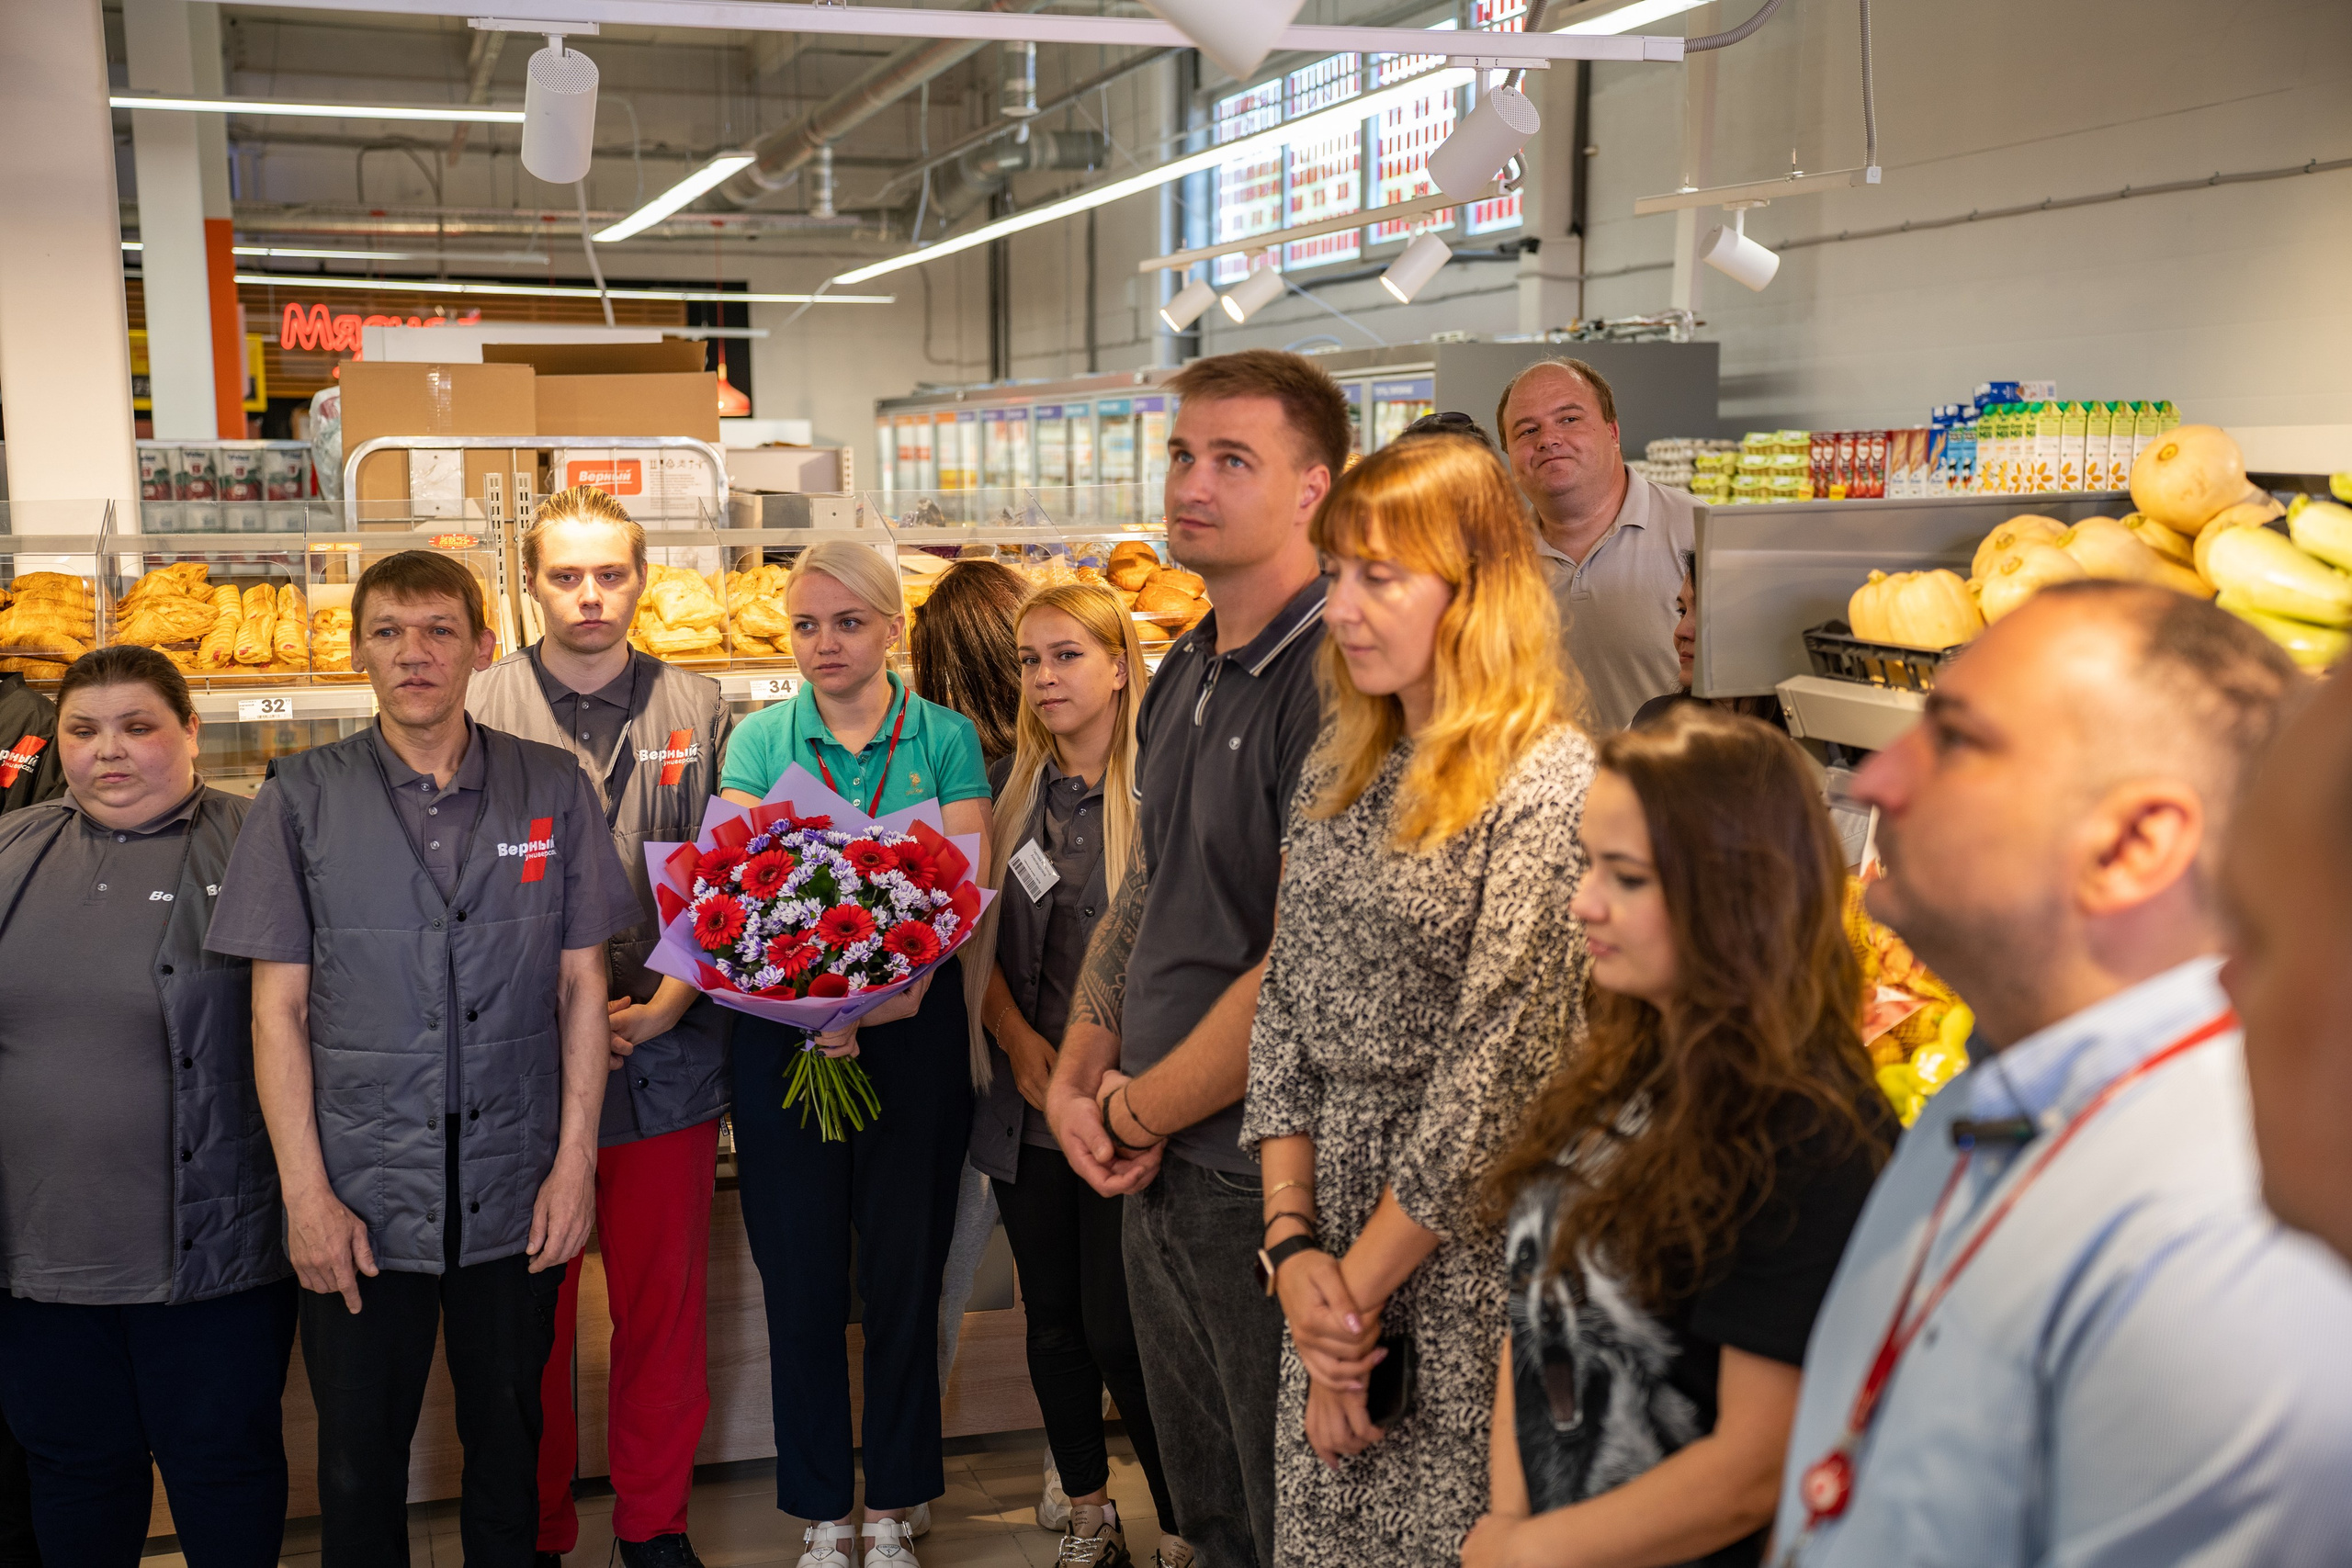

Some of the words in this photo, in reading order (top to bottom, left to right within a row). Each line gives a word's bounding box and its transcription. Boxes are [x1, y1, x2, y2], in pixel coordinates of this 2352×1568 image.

[578, 468, 633, 484] Верный
[769, 680, 792, 694] 34
[261, 698, 286, 714] 32
[639, 742, 698, 762] Верный
